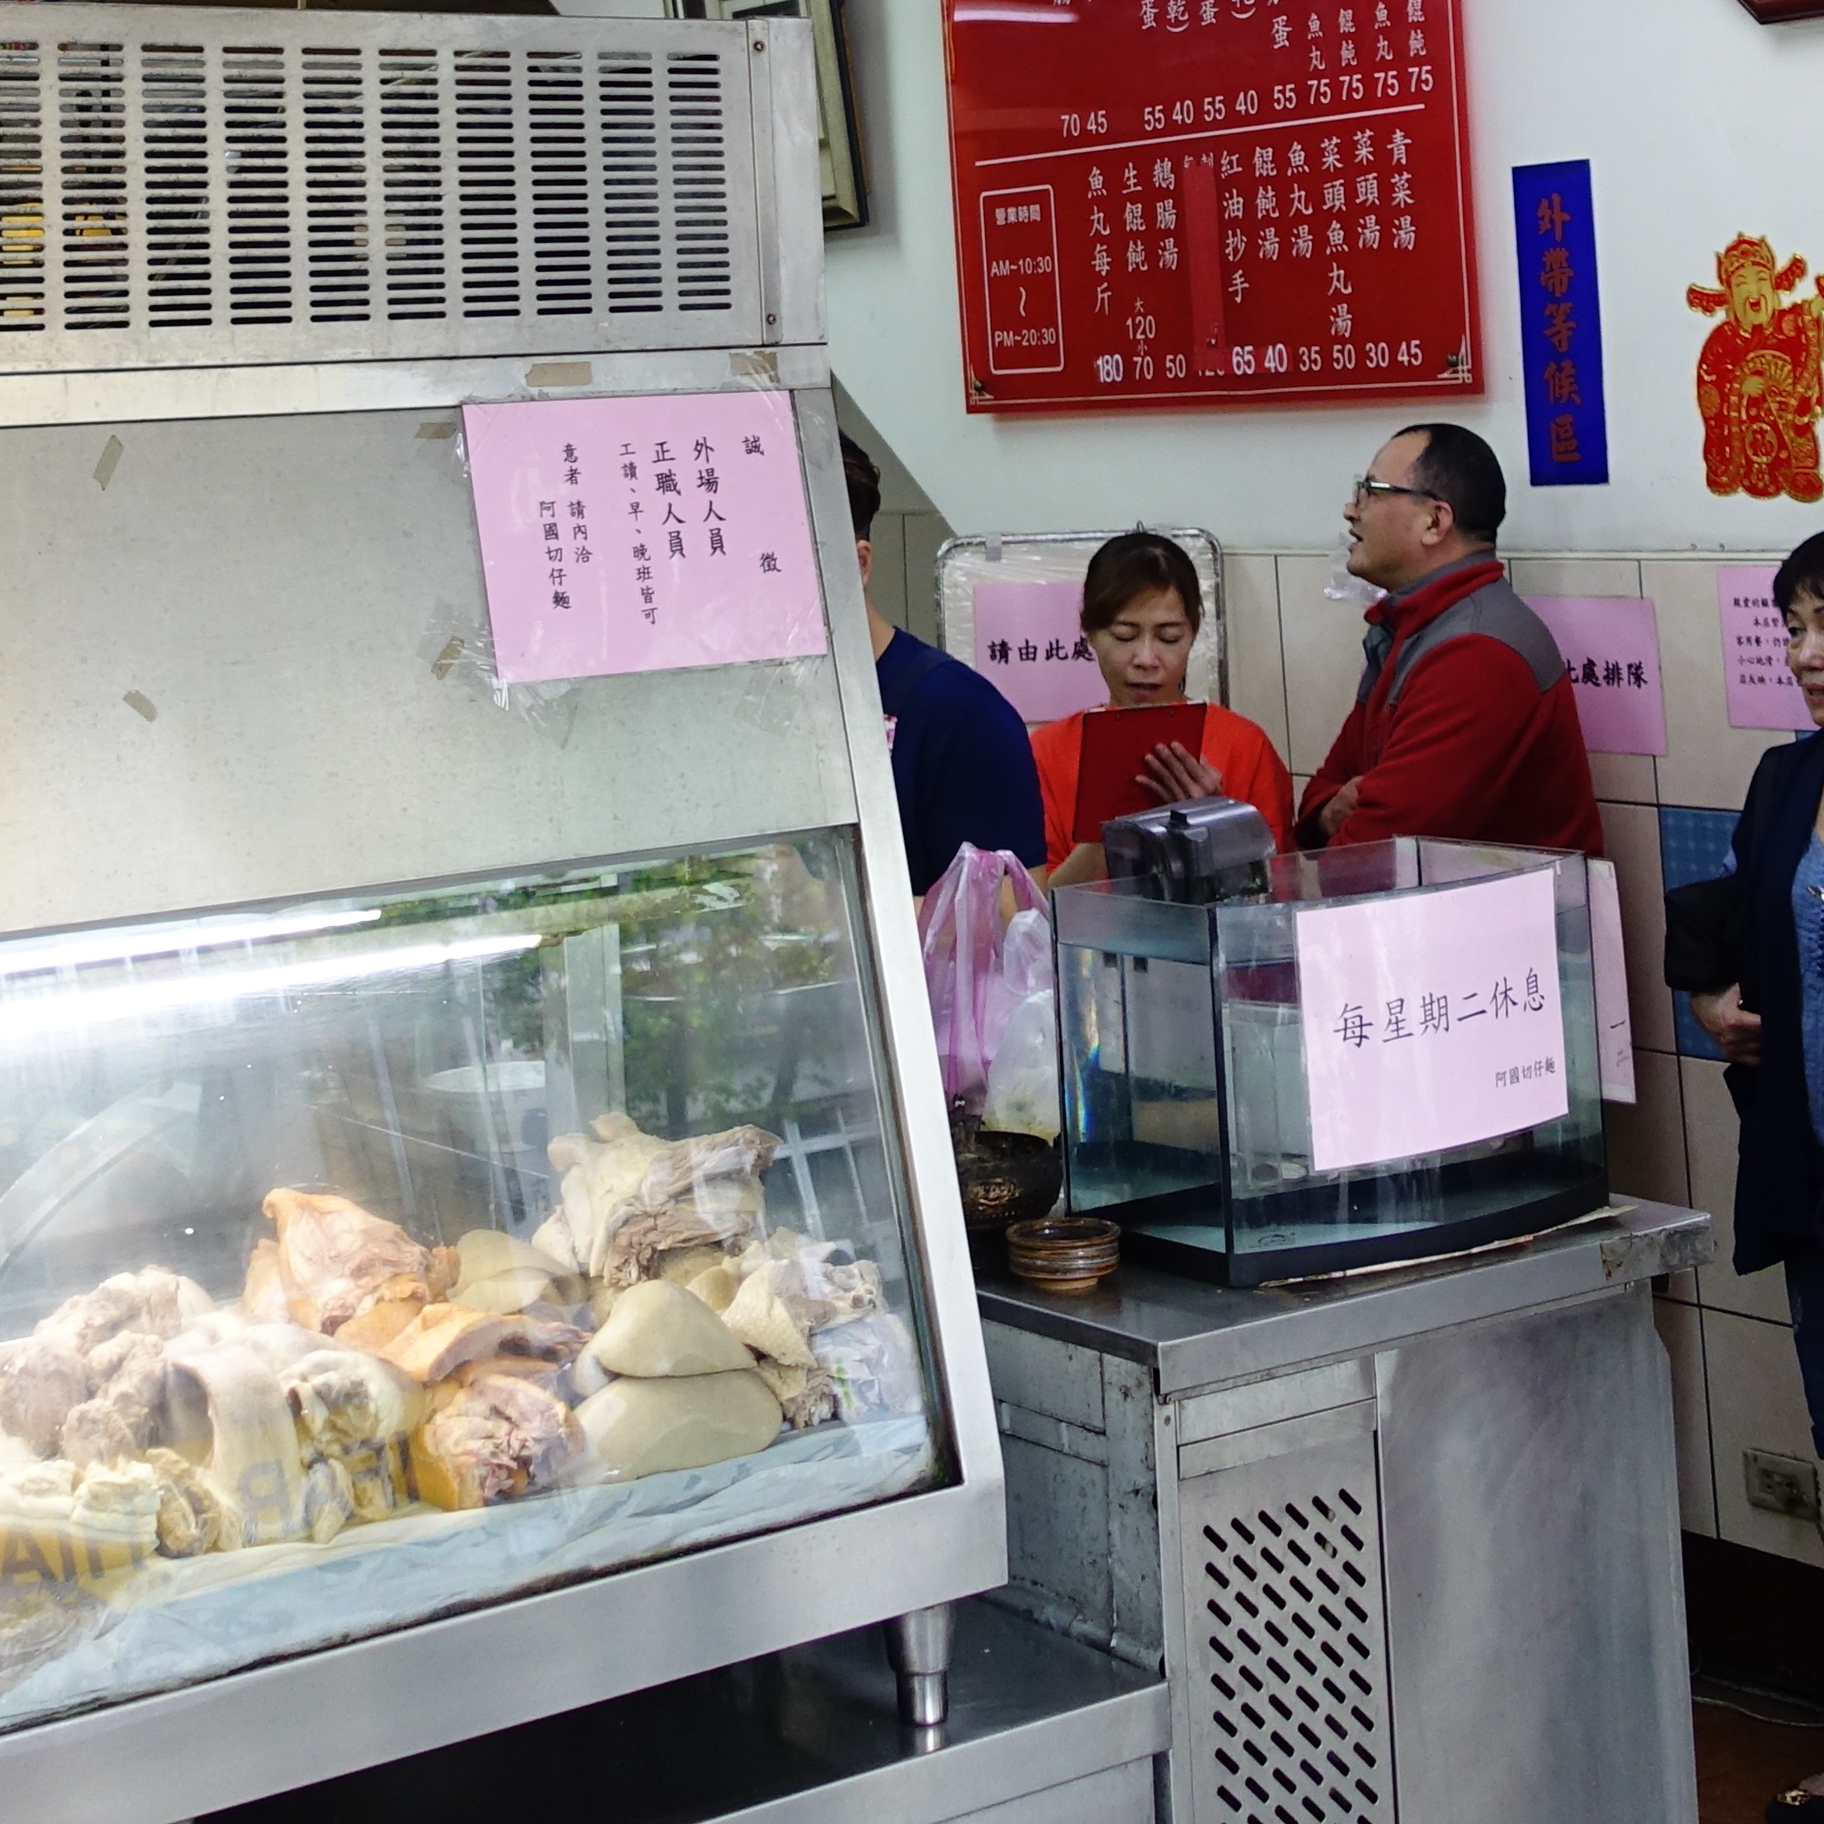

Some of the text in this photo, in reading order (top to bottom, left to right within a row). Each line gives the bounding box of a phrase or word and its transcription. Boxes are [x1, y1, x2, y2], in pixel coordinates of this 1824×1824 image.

[1308, 13, 1325, 72] 魚丸
[1375, 2, 1393, 62] 魚丸
[1308, 79, 1331, 104] 75
[1339, 74, 1364, 100] 75
[1374, 71, 1399, 97] 75
[1408, 65, 1433, 93] 75
[1203, 96, 1225, 121] 55
[1236, 90, 1258, 115] 40
[1273, 83, 1296, 110] 55
[1061, 113, 1080, 138] 70
[1086, 109, 1108, 135] 45
[1143, 105, 1165, 131] 55
[1172, 100, 1194, 125] 40
[1287, 141, 1314, 259] 魚丸湯
[1353, 128, 1381, 250] 菜頭湯
[1386, 128, 1417, 251] 青菜湯
[995, 204, 1041, 226] 營業時間
[1122, 162, 1148, 273] 生餛飩
[1153, 157, 1179, 271] 鵝腸湯
[1252, 146, 1280, 262] 餛飩湯
[1087, 166, 1113, 315] 魚丸每斤
[1220, 150, 1250, 303] 紅油抄手
[1320, 136, 1353, 338] 菜頭魚丸湯
[1126, 315, 1156, 340] 120
[1537, 192, 1582, 463] 外帶等候區
[1165, 354, 1187, 378] 50
[1231, 345, 1256, 376] 65
[1264, 343, 1288, 373] 40
[1299, 346, 1322, 372] 35
[1332, 344, 1356, 370] 50
[1365, 342, 1390, 368] 30
[1397, 340, 1423, 366] 45
[1097, 354, 1124, 383] 180
[1133, 356, 1154, 380] 70
[651, 441, 687, 559] 正職人員
[693, 437, 726, 557] 外場人員
[742, 435, 782, 574] 誠 徵
[539, 500, 572, 610] 阿國切仔麵
[987, 636, 1097, 663] 請由此處
[1333, 967, 1546, 1049] 每星期二休息
[1495, 1057, 1557, 1088] 阿國切仔麵
